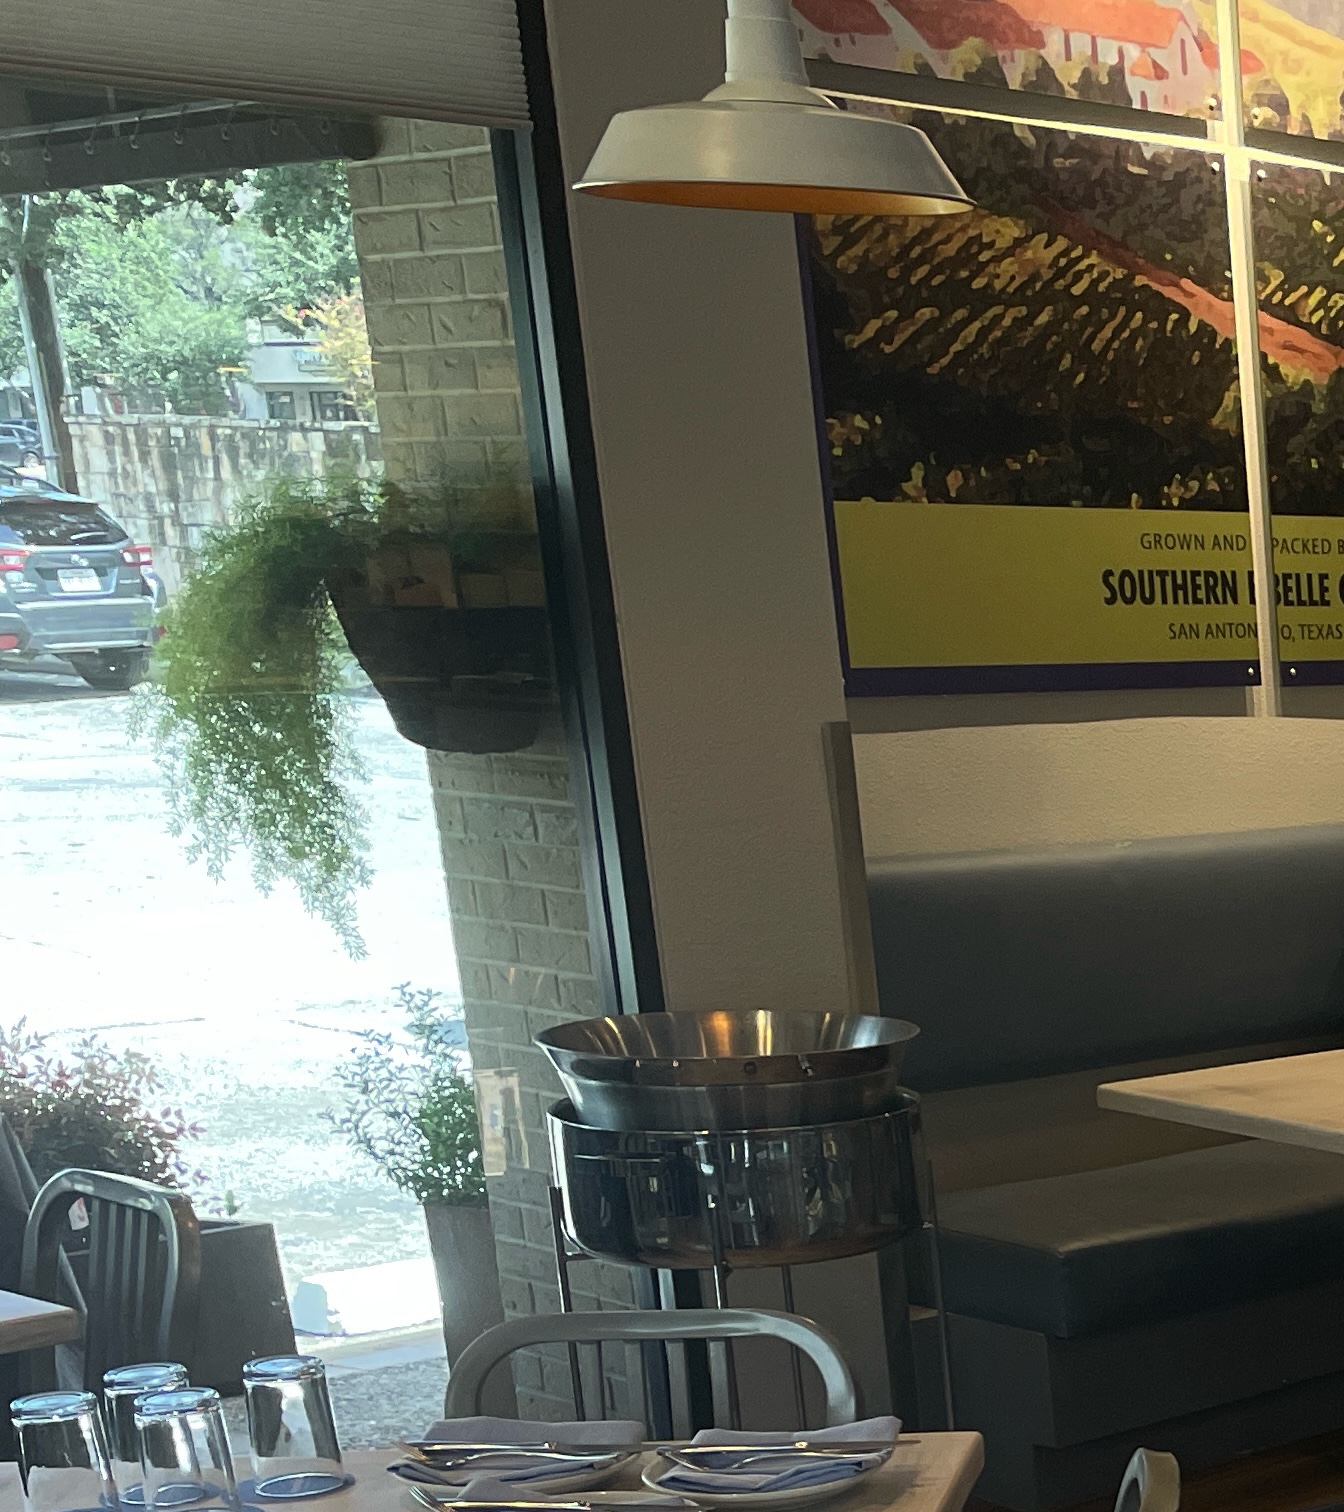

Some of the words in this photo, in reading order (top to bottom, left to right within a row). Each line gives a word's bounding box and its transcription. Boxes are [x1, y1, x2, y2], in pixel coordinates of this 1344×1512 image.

[1140, 533, 1205, 551] GROWN
[1211, 534, 1247, 551] AND
[1271, 537, 1332, 555] PACKED
[1101, 568, 1239, 606] SOUTHERN
[1168, 622, 1200, 640] SAN
[1204, 622, 1296, 643] ANTONO,
[1298, 623, 1344, 640] TEXAS
